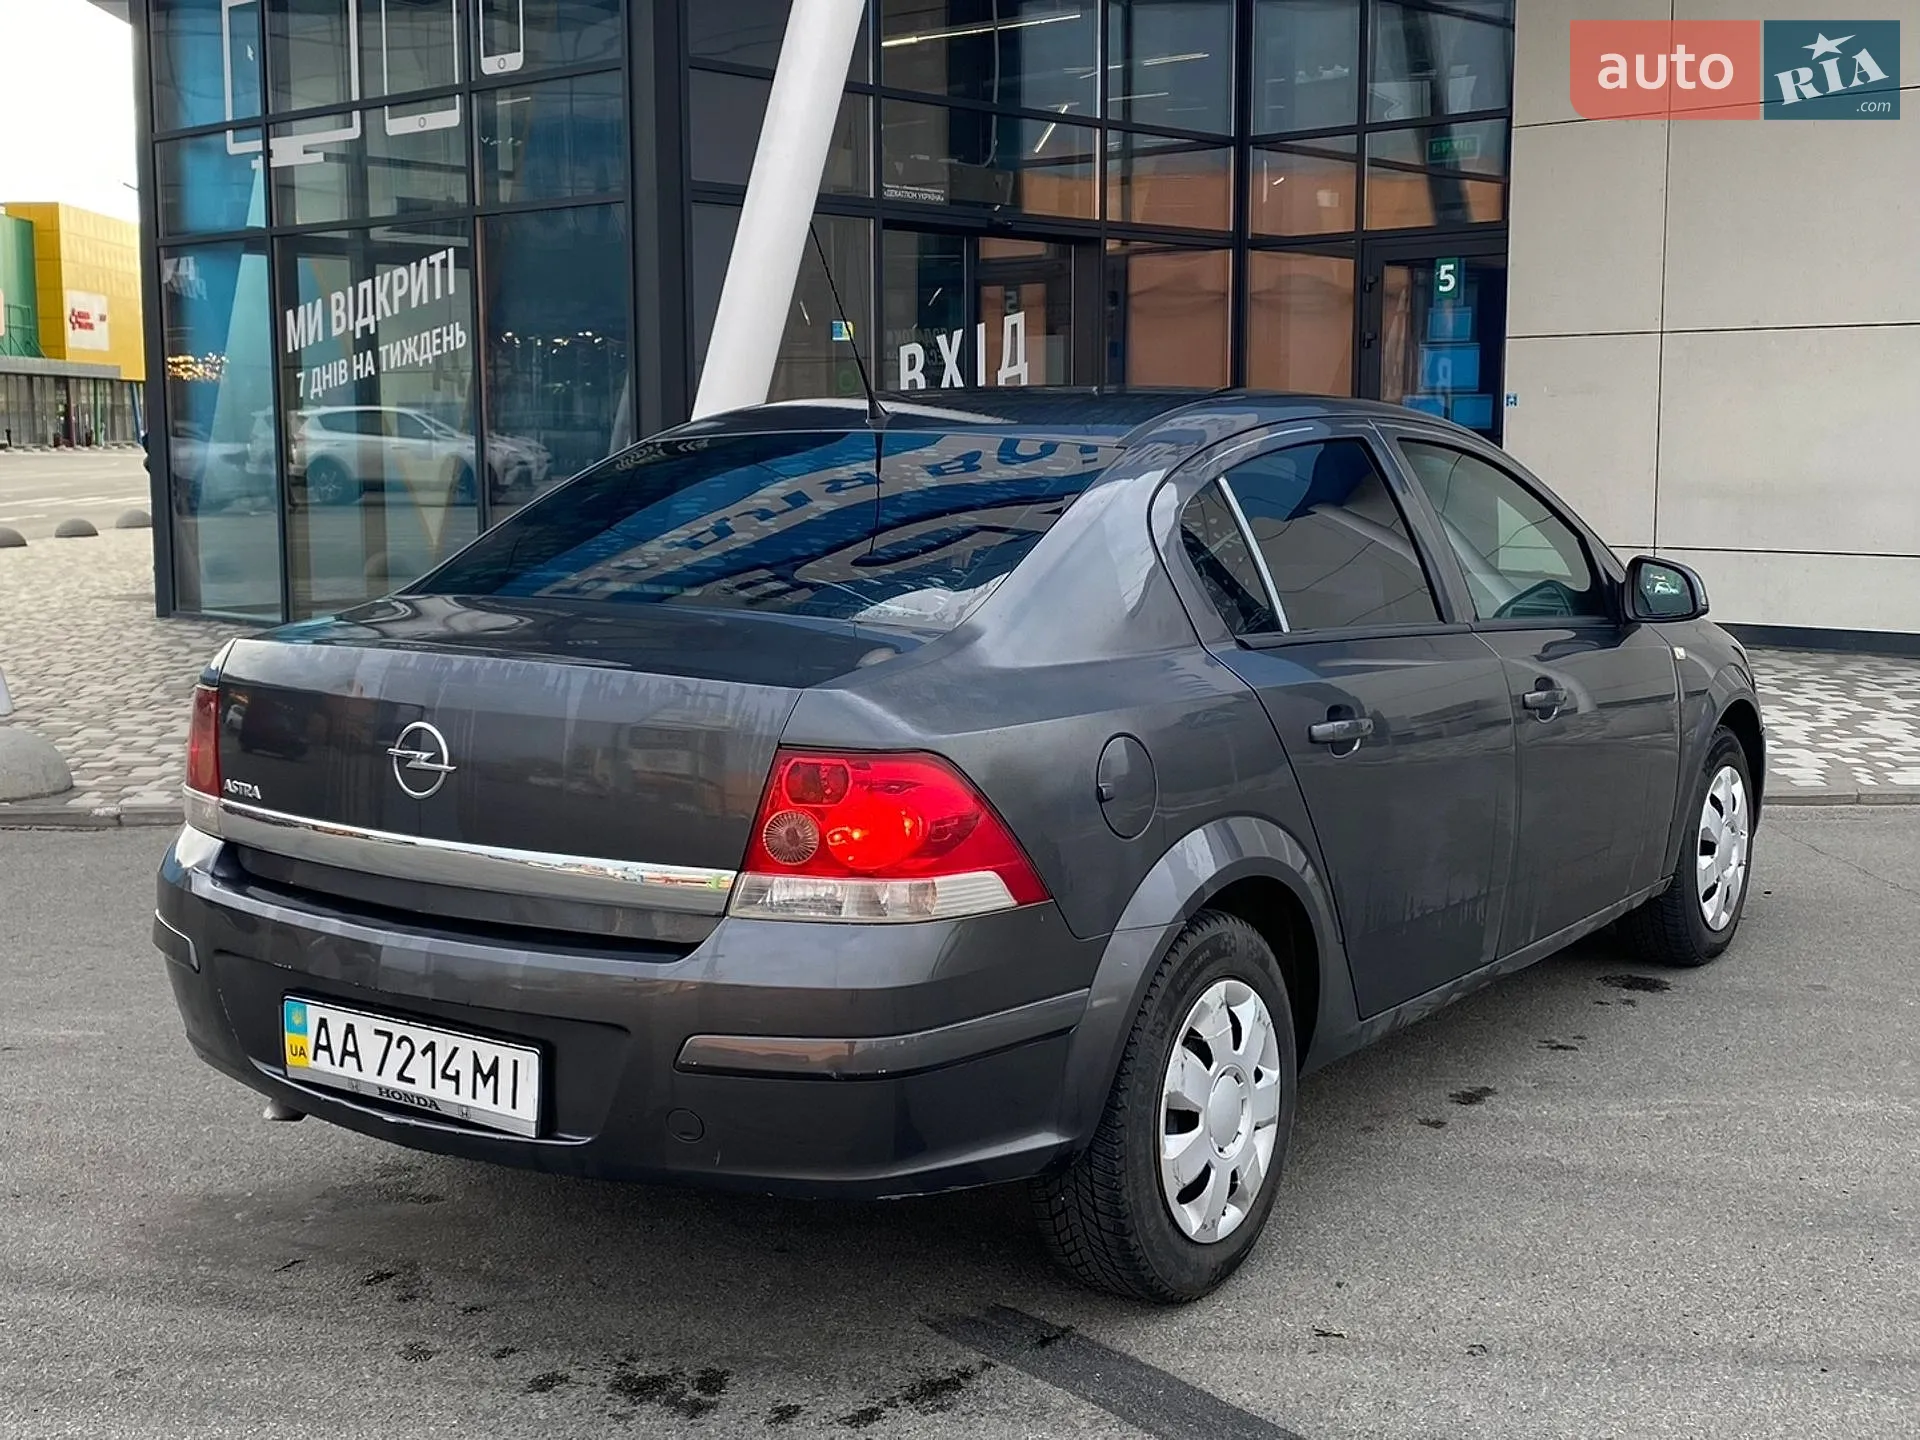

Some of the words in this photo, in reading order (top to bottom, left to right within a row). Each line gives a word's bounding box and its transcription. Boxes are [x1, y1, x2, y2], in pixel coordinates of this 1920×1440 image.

[286, 298, 324, 353] МИ
[330, 247, 456, 339] ВІДКРИТІ
[1439, 264, 1456, 292] 5
[296, 368, 306, 398] 7
[310, 358, 349, 400] ДНІВ
[353, 350, 375, 381] НА
[378, 321, 467, 372] ТИЖДЕНЬ
[900, 311, 1028, 390] ВХІД
[224, 778, 262, 800] ASTRA
[290, 1043, 307, 1059] UA
[312, 1017, 364, 1073] AA
[373, 1028, 461, 1096] 7214
[471, 1050, 519, 1110] MI
[377, 1086, 442, 1112] HONDA
